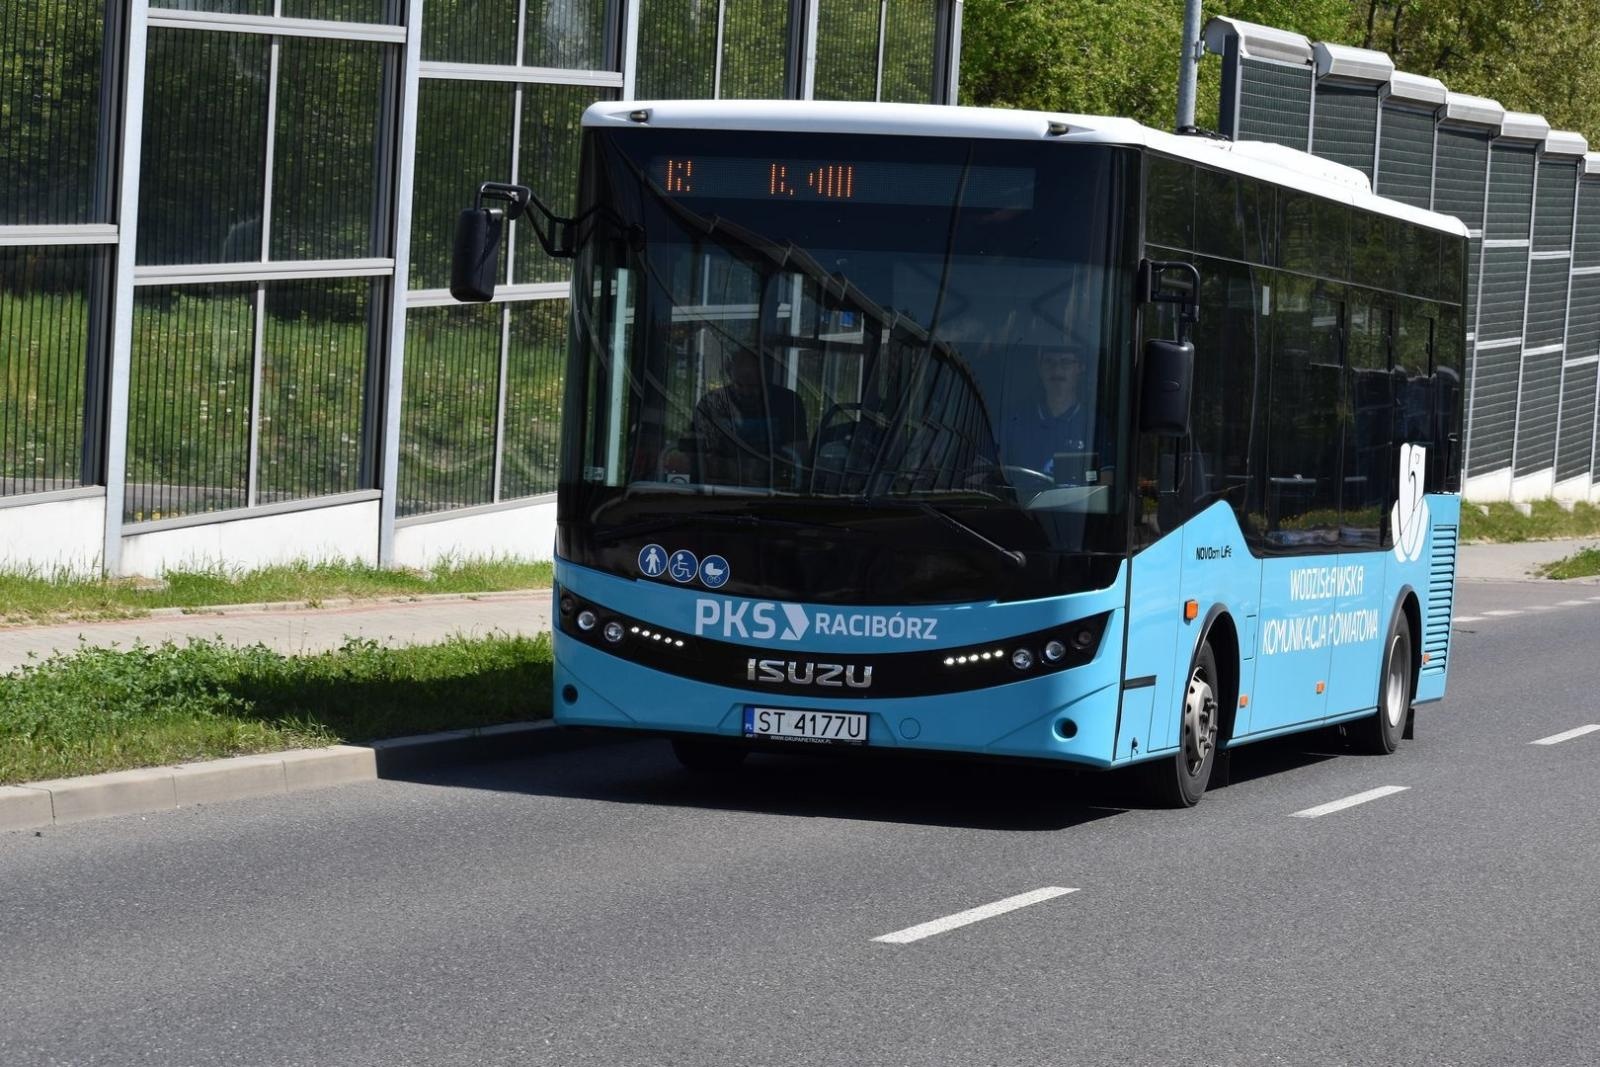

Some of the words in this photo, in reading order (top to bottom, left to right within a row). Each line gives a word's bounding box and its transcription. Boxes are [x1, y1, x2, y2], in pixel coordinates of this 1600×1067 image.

[1290, 565, 1364, 600] WODZISŁAWSKA
[695, 599, 776, 640] PKS
[815, 612, 938, 640] RACIBÓRZ
[1262, 615, 1326, 655] KOMUNIKACJA
[1327, 609, 1378, 646] POWIATOWA
[747, 658, 872, 688] ISUZU
[758, 711, 786, 733] ST
[794, 713, 861, 738] 4177U
